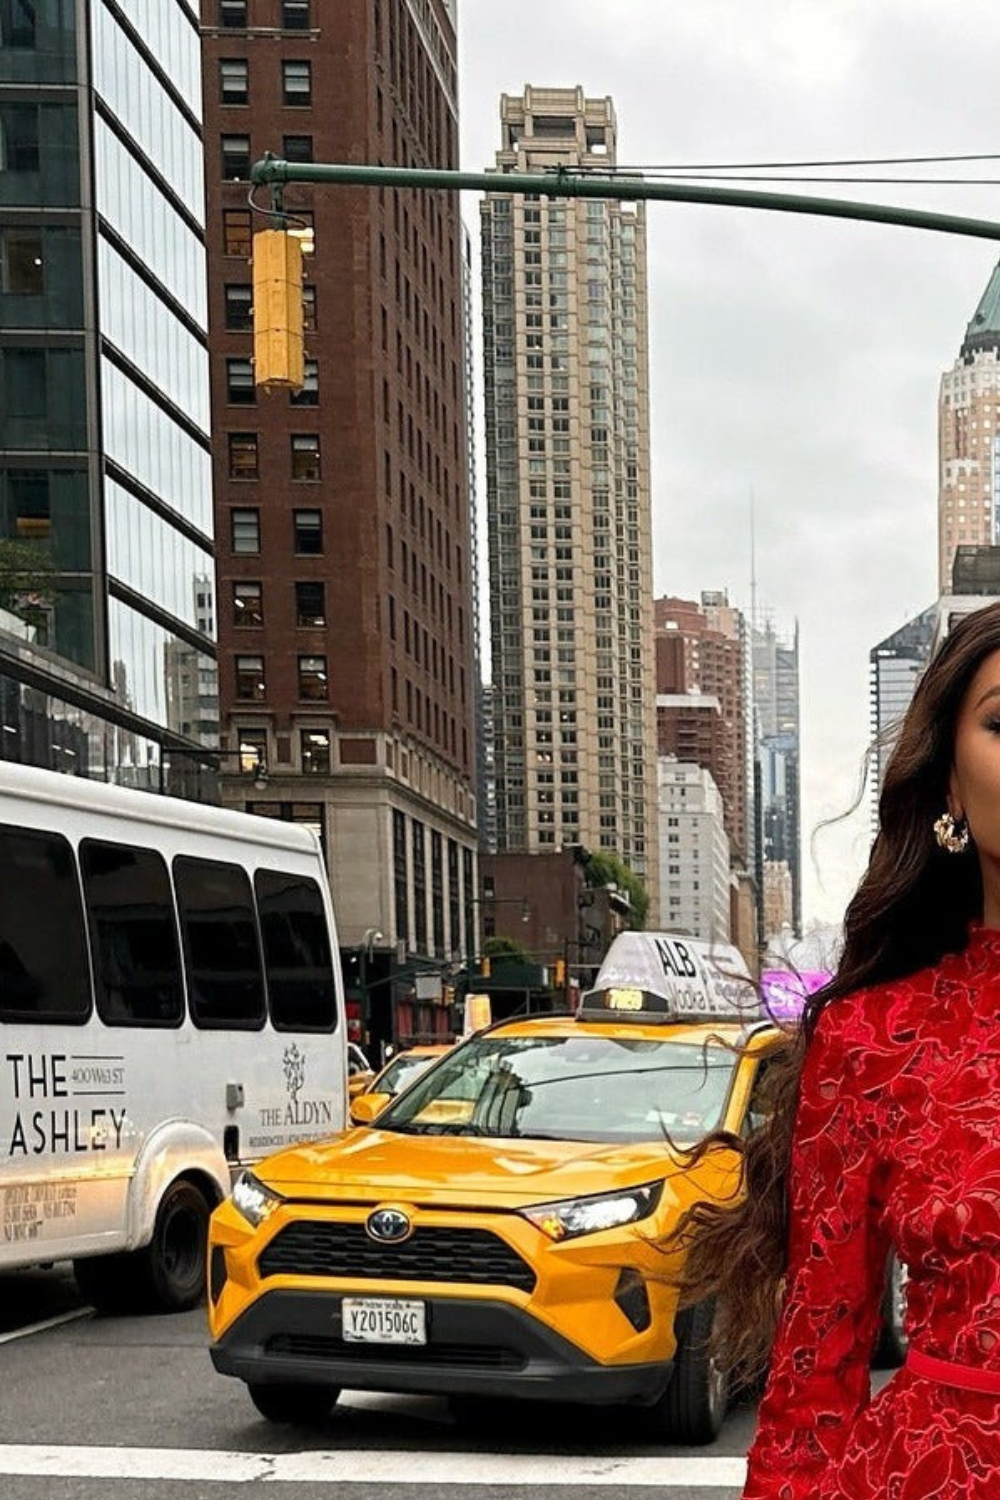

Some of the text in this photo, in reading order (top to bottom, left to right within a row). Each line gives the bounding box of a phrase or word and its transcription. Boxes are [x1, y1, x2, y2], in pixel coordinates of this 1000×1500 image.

[654, 939, 697, 978] ALB
[6, 1054, 68, 1098] THE
[9, 1108, 126, 1155] ASHLEY
[259, 1101, 331, 1126] THE ALDYN
[350, 1309, 419, 1333] Y201506C
